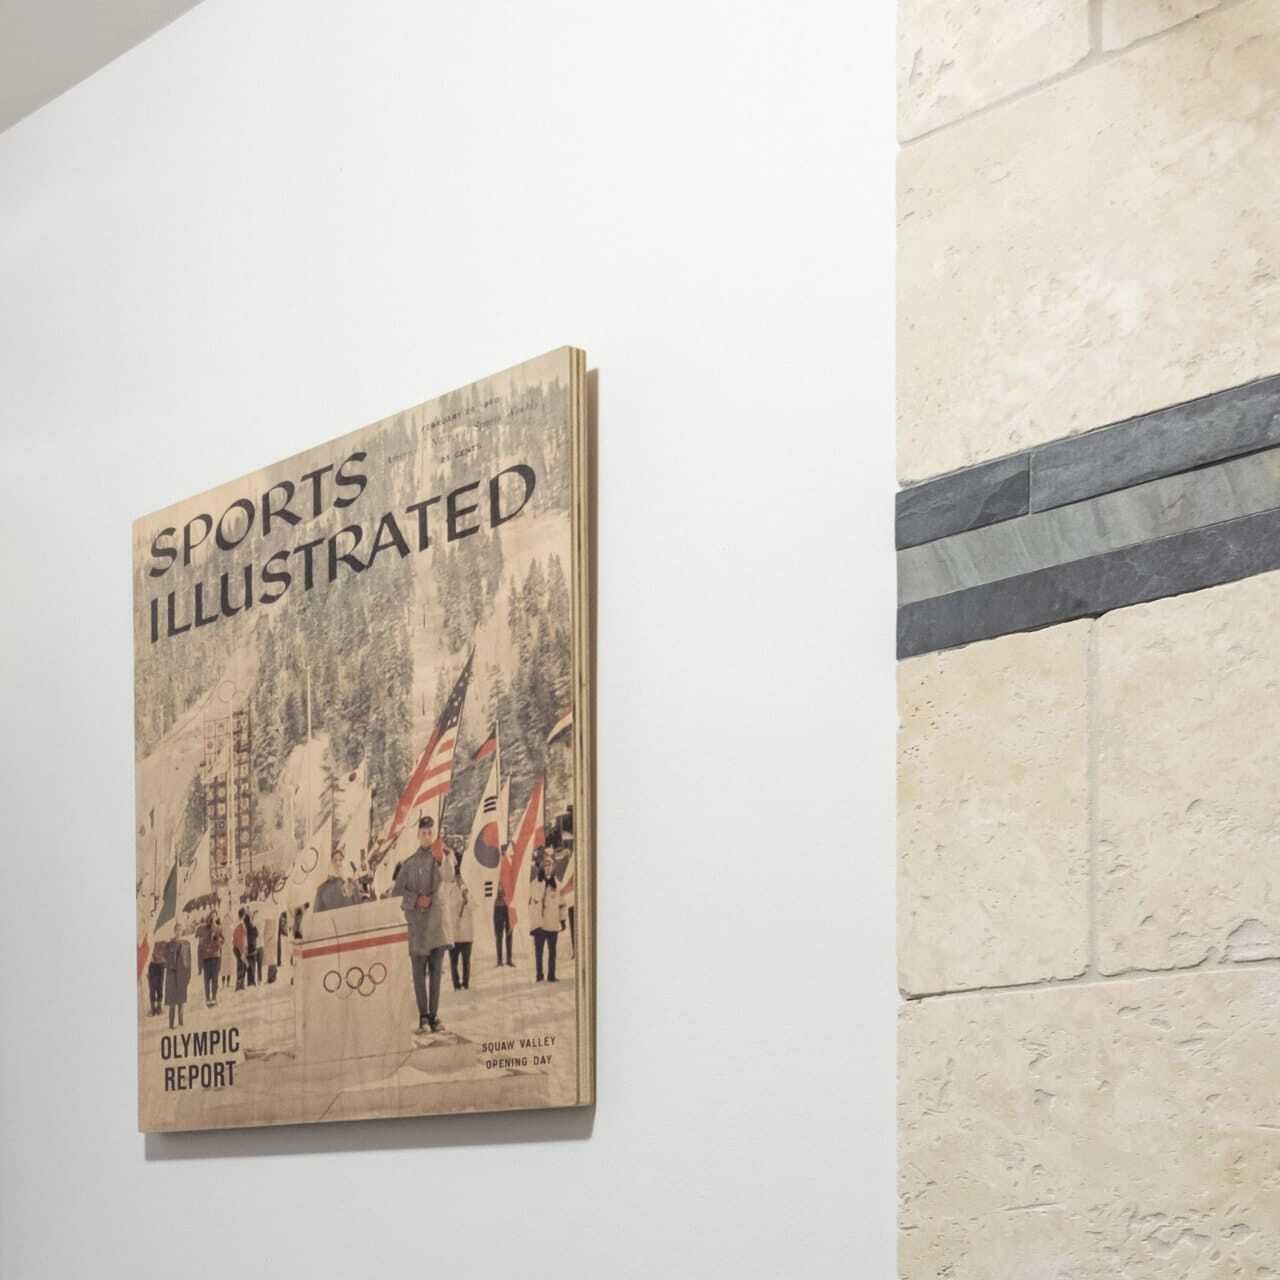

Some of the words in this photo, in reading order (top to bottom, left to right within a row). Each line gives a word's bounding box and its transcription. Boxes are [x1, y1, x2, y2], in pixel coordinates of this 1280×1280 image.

[149, 452, 368, 578] SPORTS
[150, 464, 537, 644] ILLUSTRATED
[160, 1027, 240, 1060] OLYMPIC
[482, 1040, 515, 1054] SQUAW
[520, 1036, 556, 1049] VALLEY
[164, 1060, 237, 1092] REPORT
[486, 1056, 528, 1070] OPENING
[533, 1055, 553, 1066] DAY
